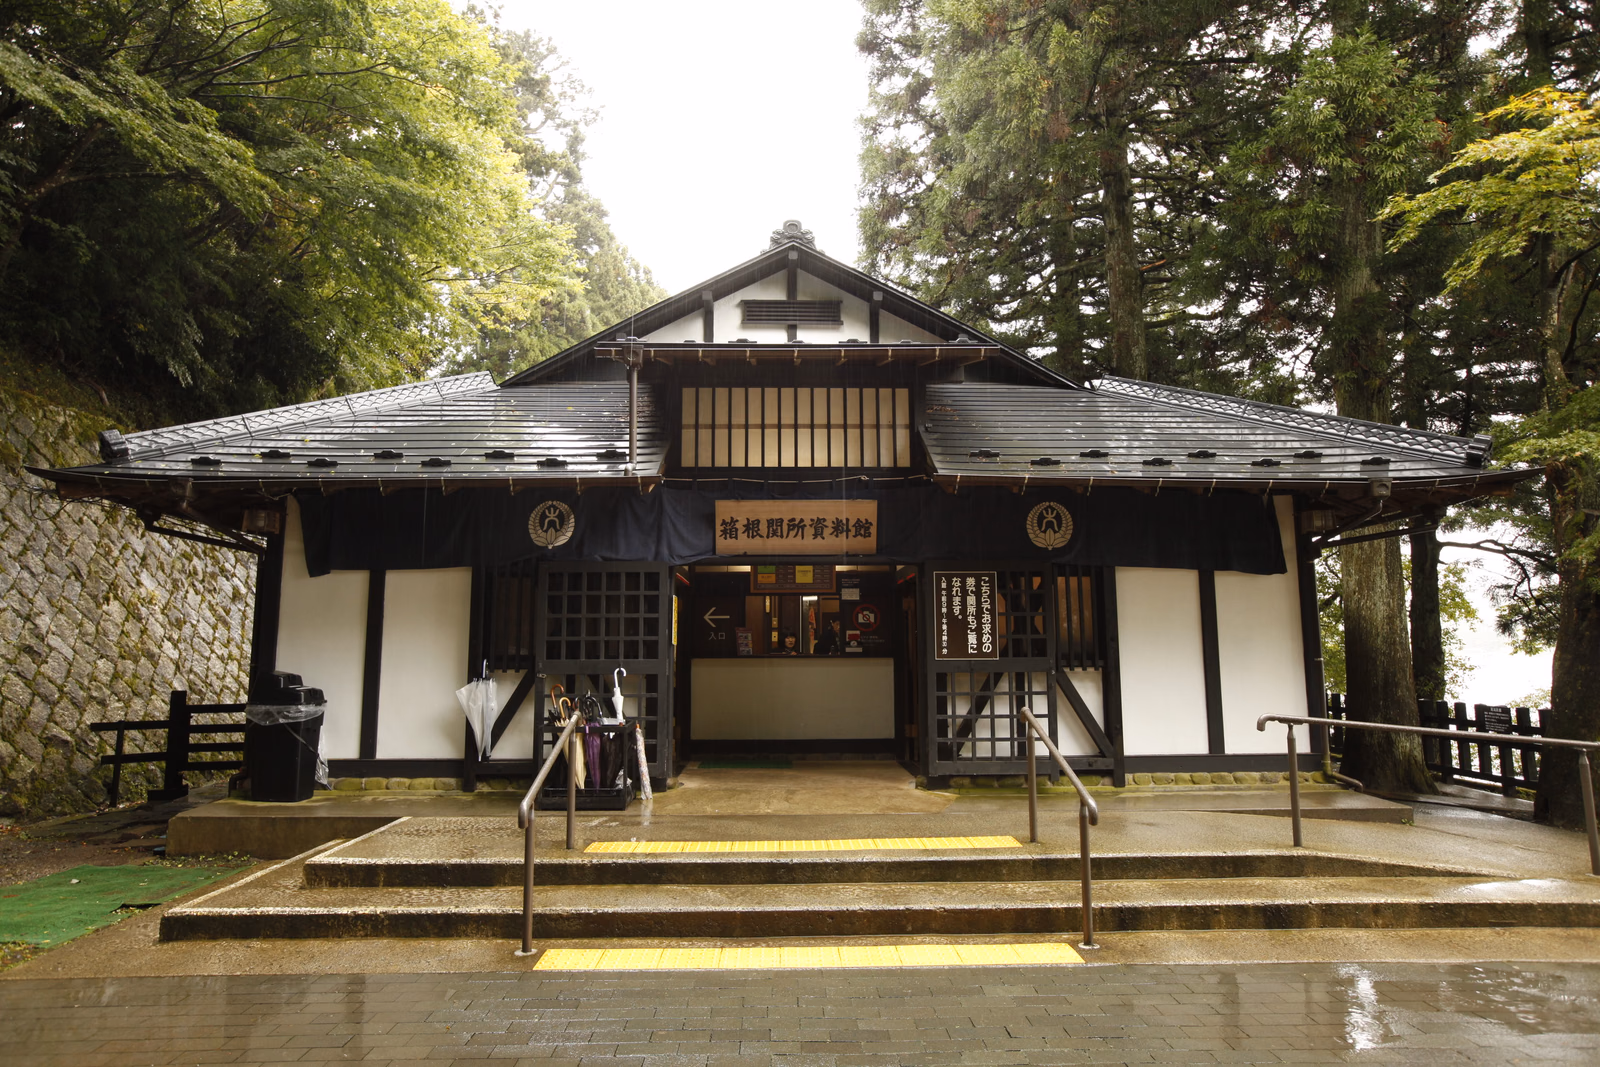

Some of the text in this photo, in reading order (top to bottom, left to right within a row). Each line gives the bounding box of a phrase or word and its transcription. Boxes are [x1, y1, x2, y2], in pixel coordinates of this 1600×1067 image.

[719, 516, 874, 540] 箱根関所資料館
[952, 577, 963, 620] なれます。
[966, 577, 977, 654] 券で関所もご覧に
[981, 576, 992, 653] こちらでお求めの
[709, 632, 726, 640] 入口
